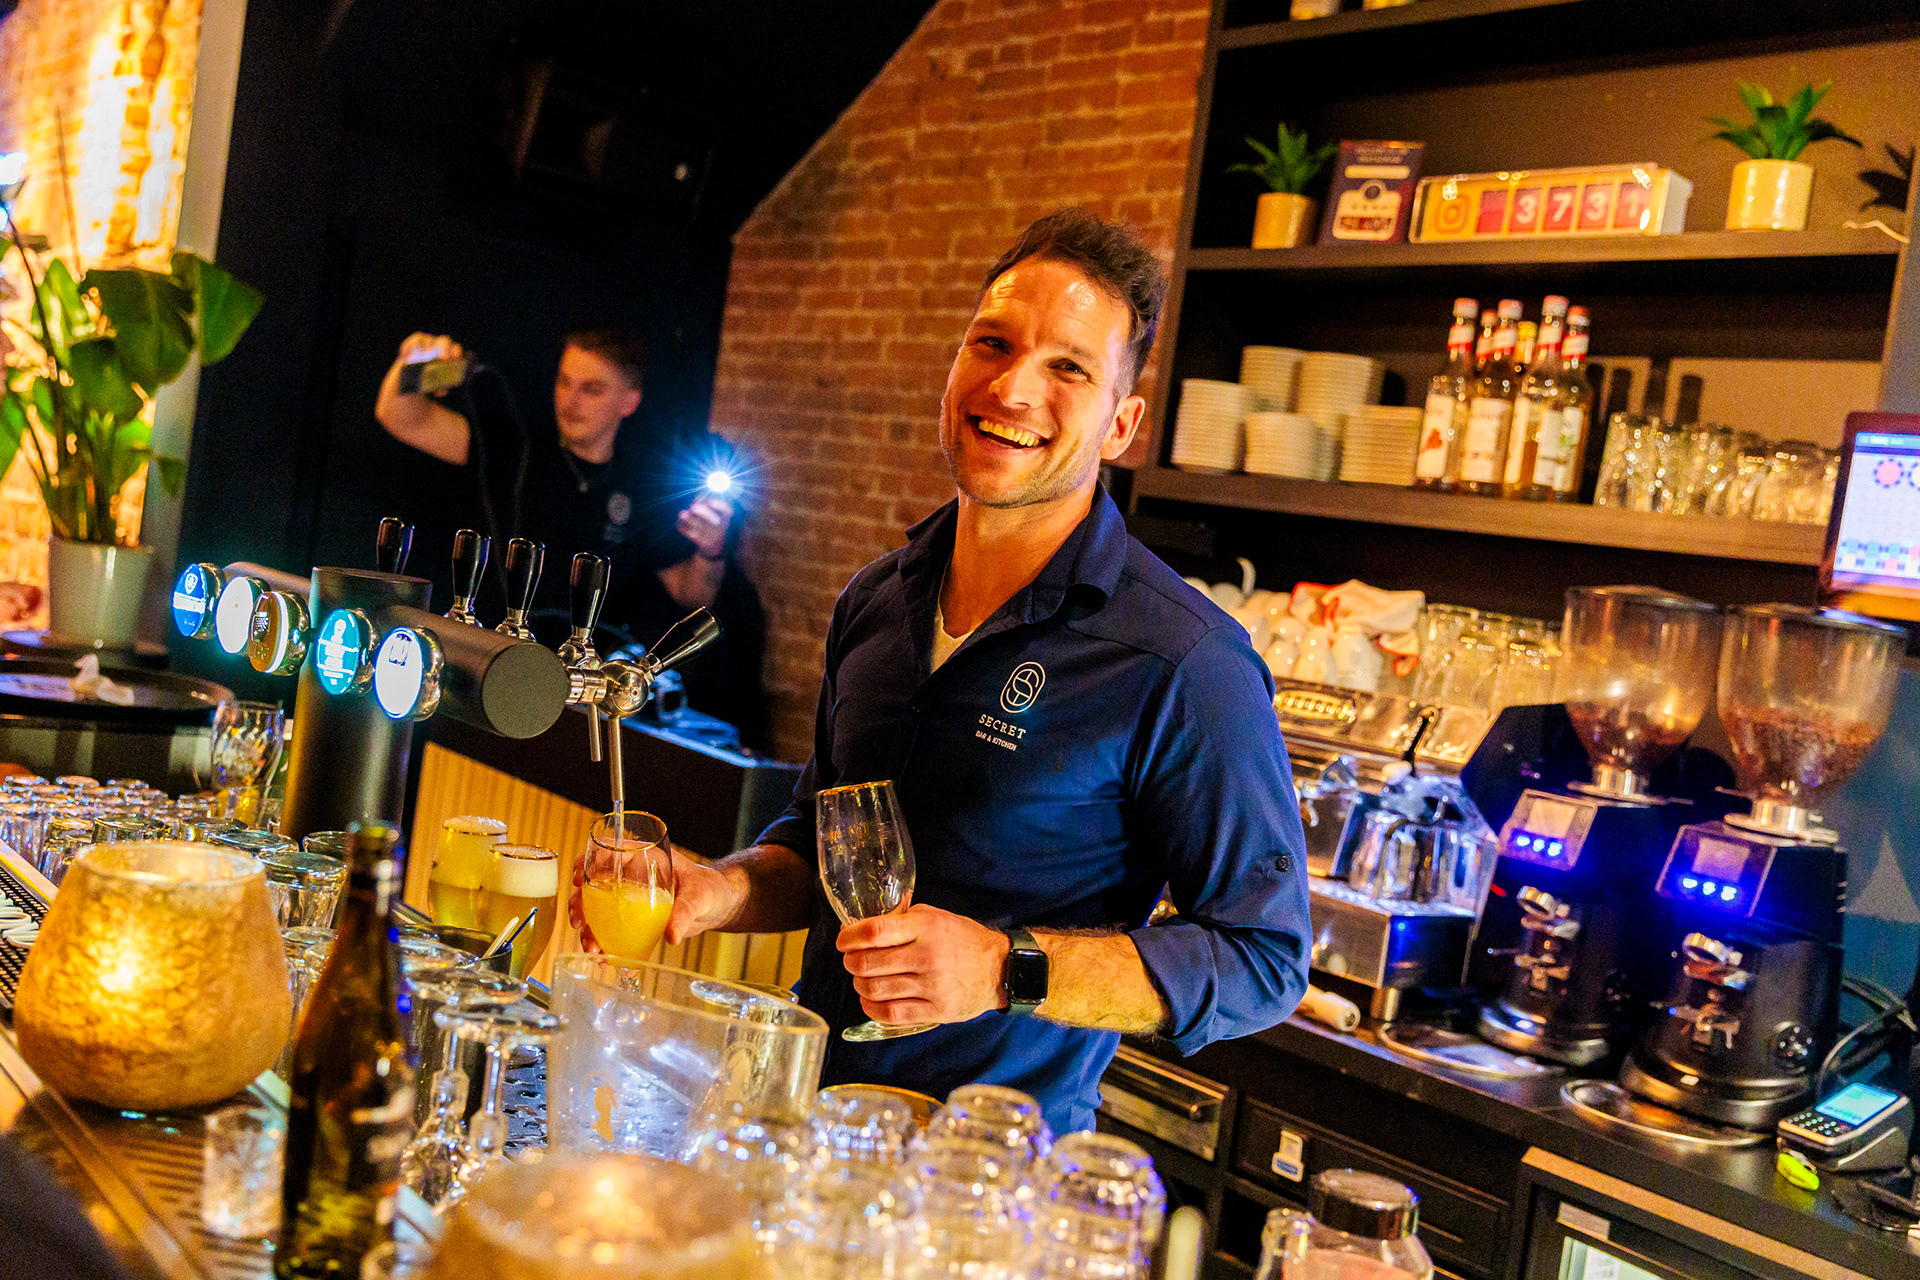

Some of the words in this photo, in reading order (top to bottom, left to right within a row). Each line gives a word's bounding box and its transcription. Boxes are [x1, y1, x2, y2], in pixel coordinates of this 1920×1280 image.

[979, 714, 1026, 739] SECRET
[975, 730, 987, 740] BAR
[992, 737, 1017, 751] KITCHEN
